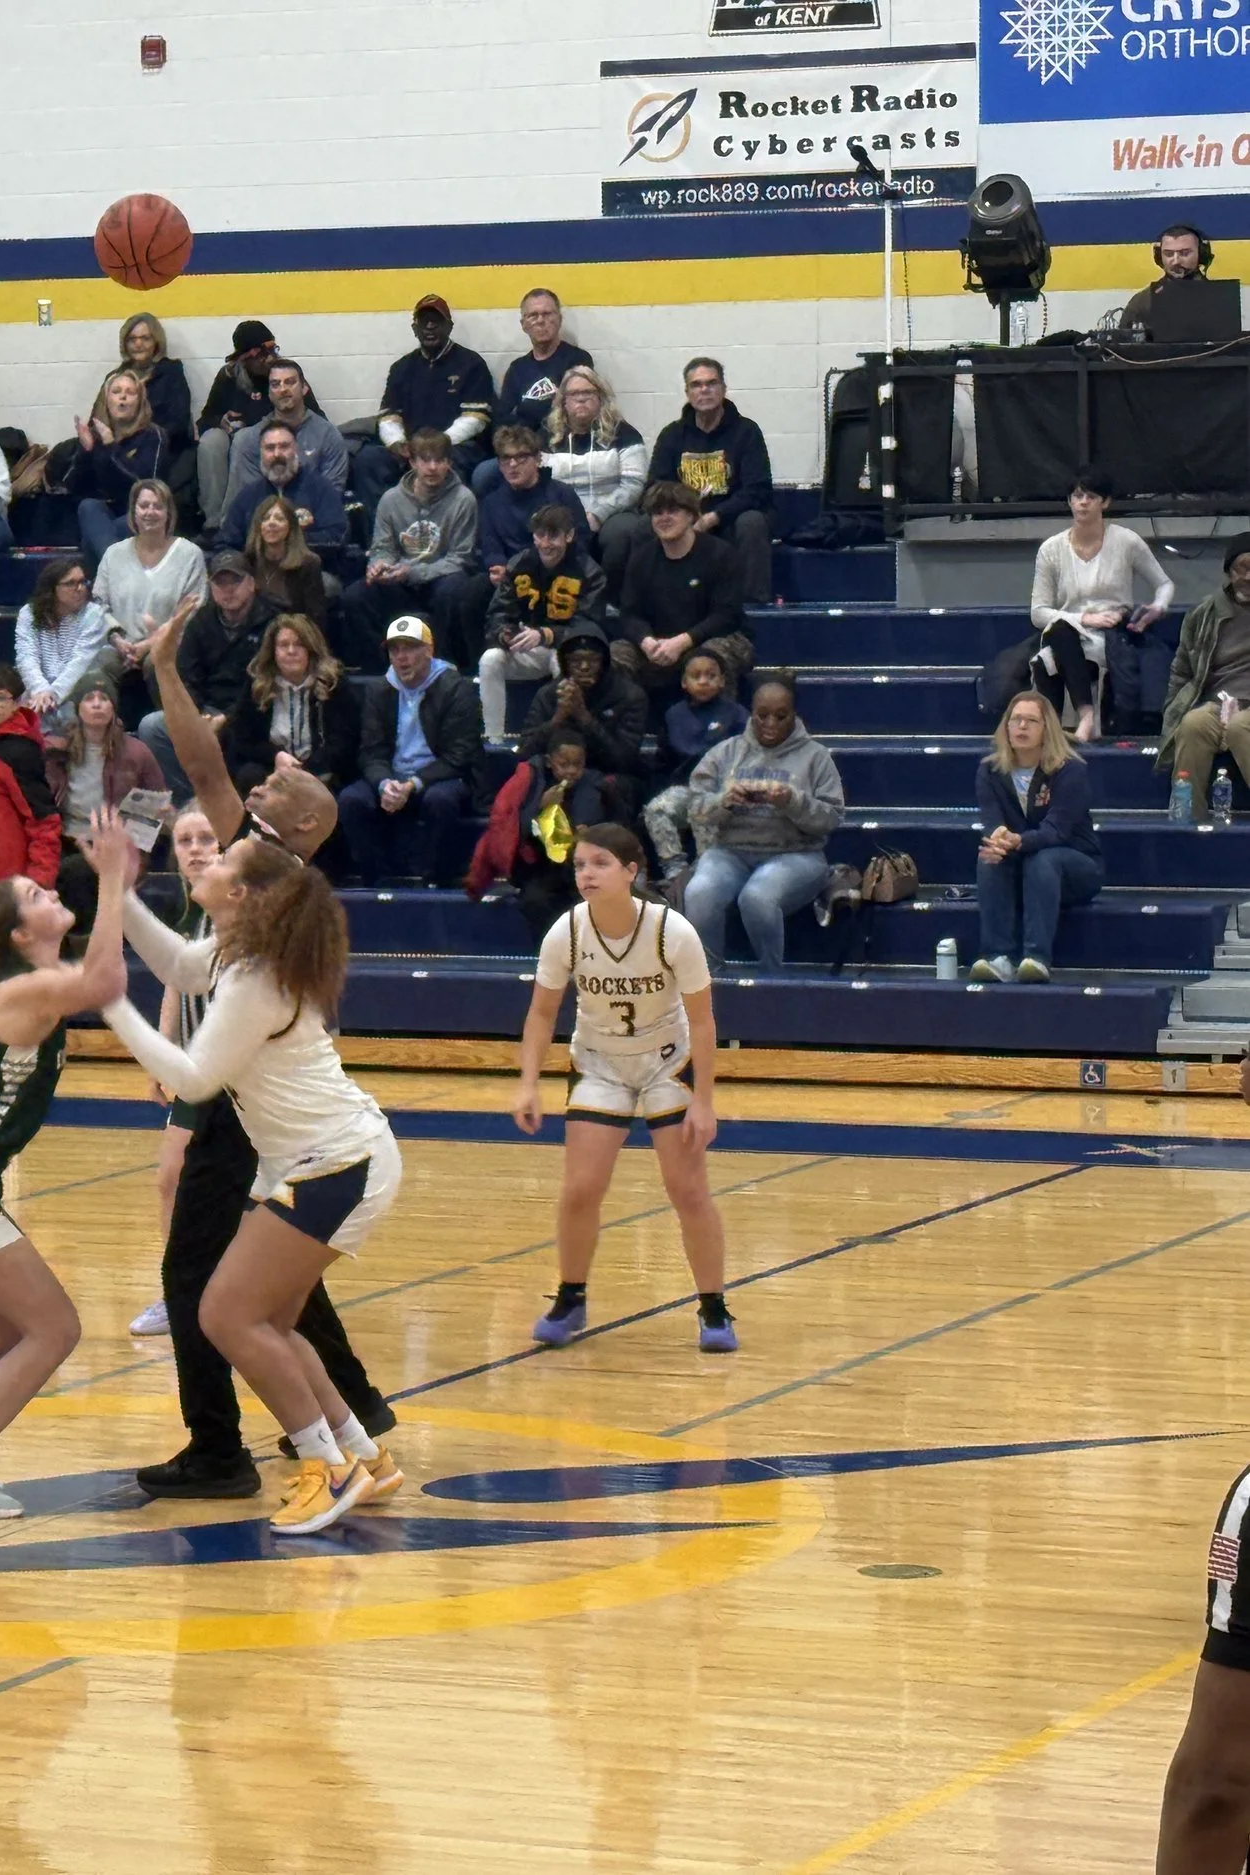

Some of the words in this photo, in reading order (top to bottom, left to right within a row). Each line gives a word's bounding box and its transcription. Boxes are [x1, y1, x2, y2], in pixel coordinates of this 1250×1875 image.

[754, 12, 771, 27] of
[775, 5, 836, 26] KENT
[718, 90, 842, 119] Rocket
[849, 84, 958, 113] Radio
[713, 126, 961, 161] Cybercasts
[1112, 134, 1223, 171] Walk-in
[641, 175, 935, 210] wp.rock889.com/rocketadio
[578, 971, 666, 996] ROCKETS
[609, 1001, 636, 1037] 3
